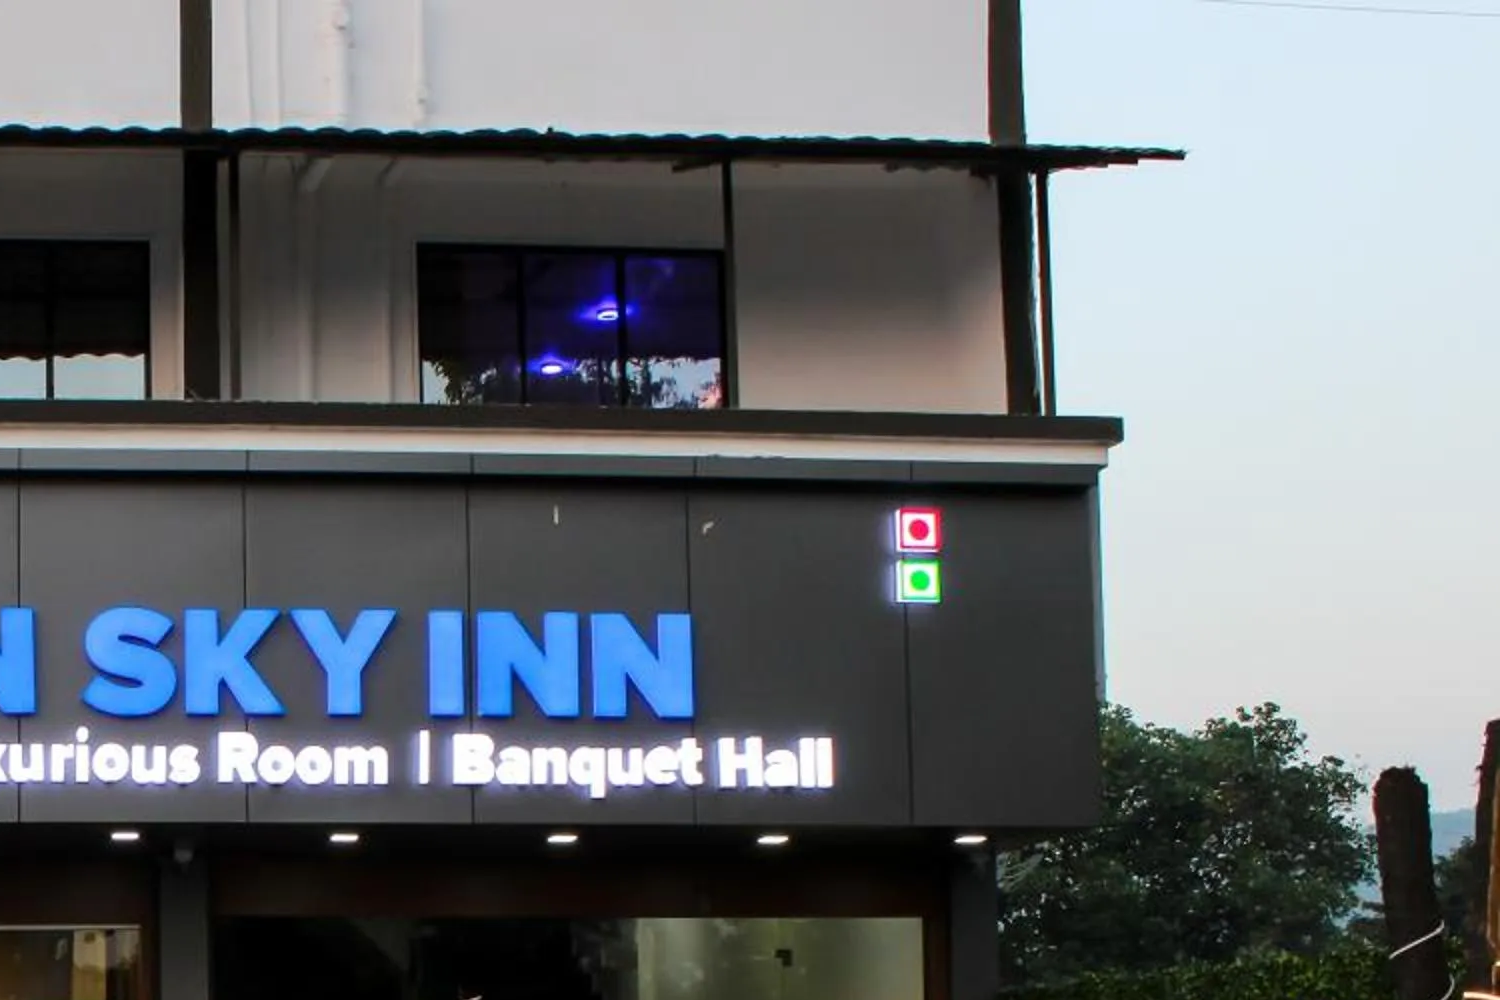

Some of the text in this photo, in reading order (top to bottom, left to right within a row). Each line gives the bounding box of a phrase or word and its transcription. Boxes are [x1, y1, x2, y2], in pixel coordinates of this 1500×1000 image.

[81, 604, 398, 718] SKY
[426, 608, 696, 720] INN
[217, 731, 389, 785] Room
[451, 732, 704, 799] Banquet
[717, 735, 835, 788] Hall
